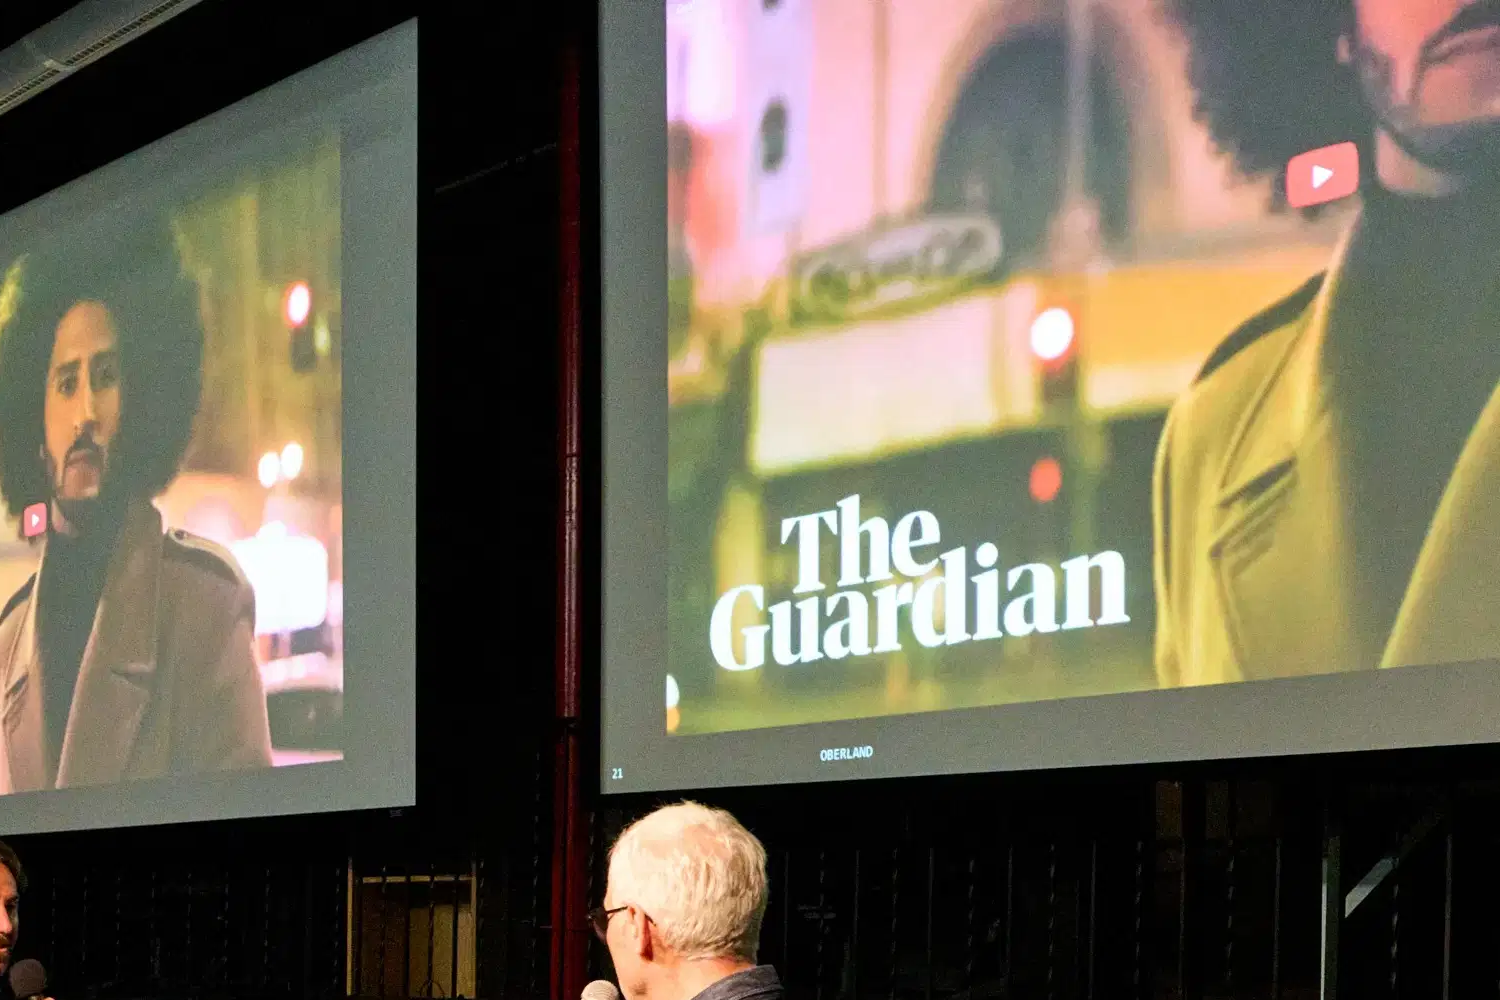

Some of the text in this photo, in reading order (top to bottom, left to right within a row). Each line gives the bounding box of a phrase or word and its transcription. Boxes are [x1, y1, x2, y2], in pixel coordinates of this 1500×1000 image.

[781, 493, 941, 594] The
[709, 541, 1131, 672] Guardian
[612, 767, 624, 780] 21
[819, 745, 874, 762] OBERLAND
